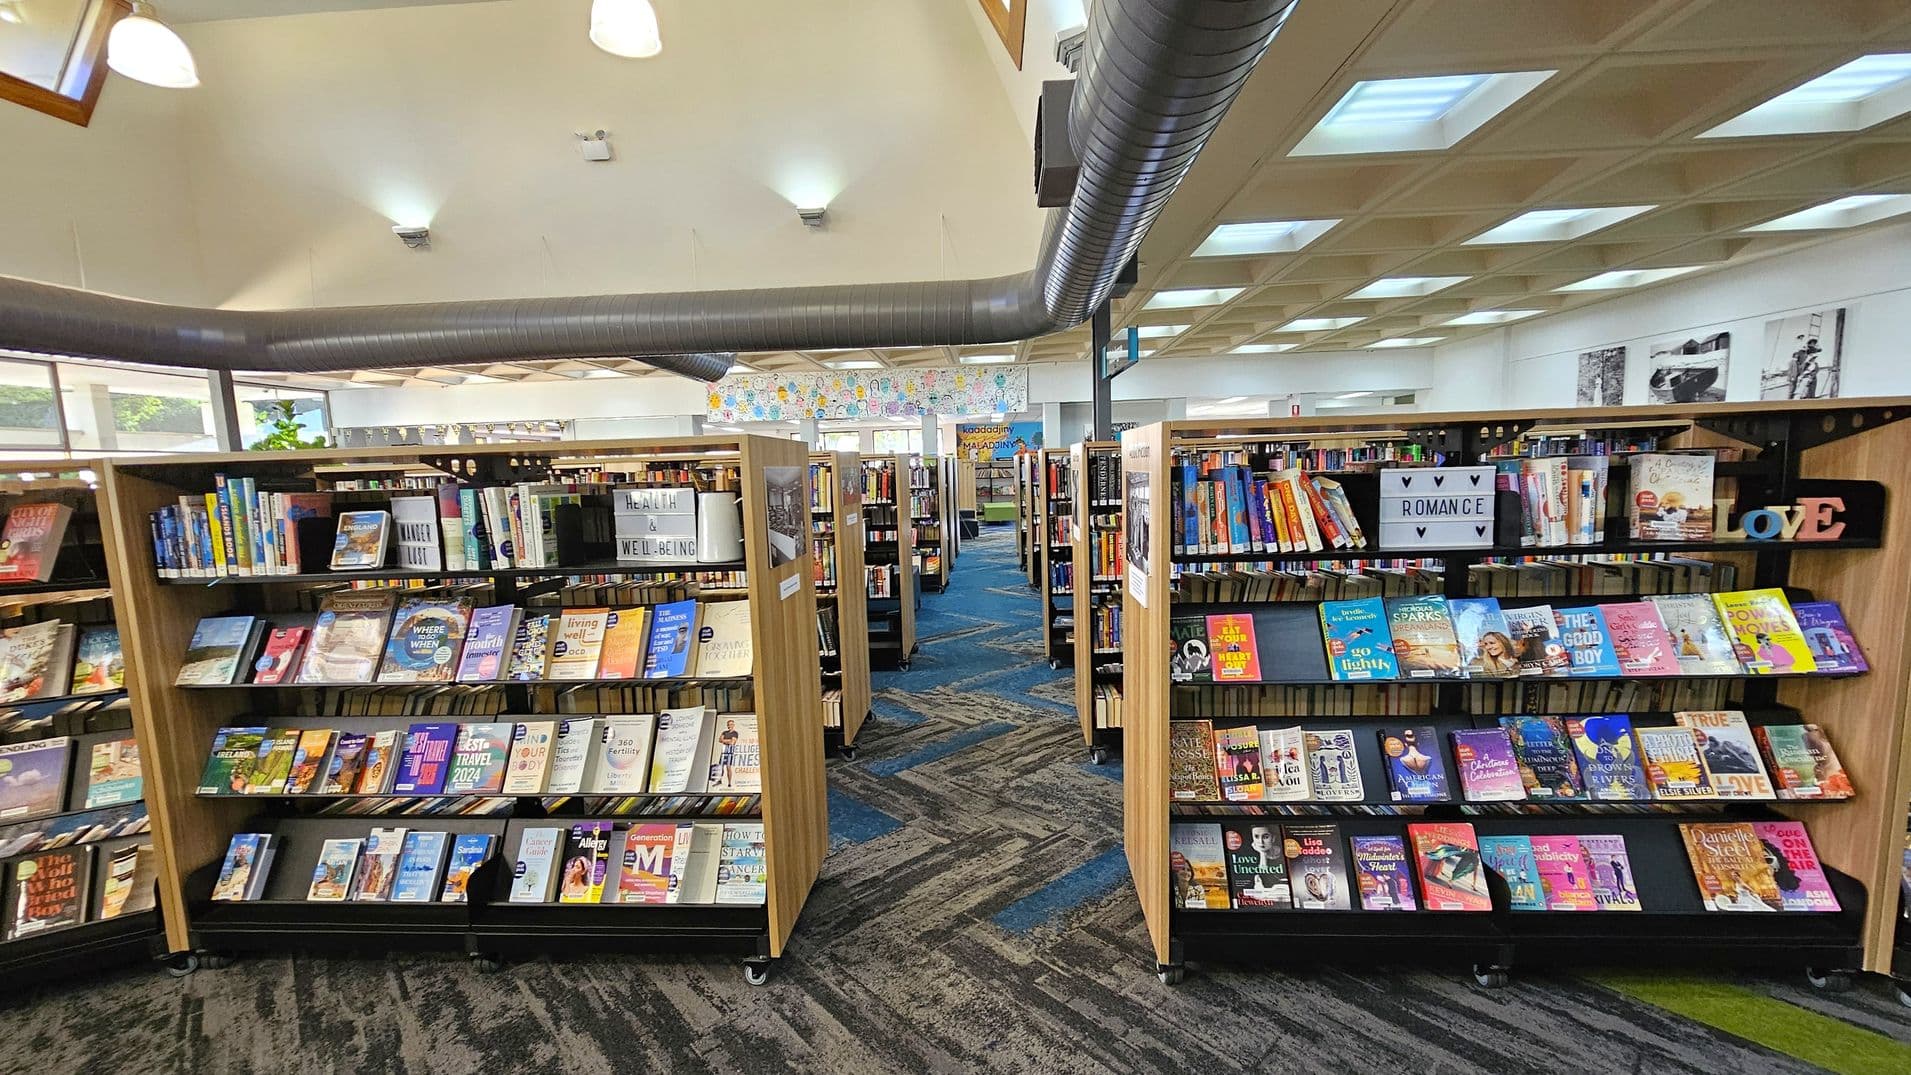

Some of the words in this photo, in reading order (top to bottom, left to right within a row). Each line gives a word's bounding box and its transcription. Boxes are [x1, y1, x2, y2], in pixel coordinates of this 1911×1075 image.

[963, 425, 1014, 434] kaadadjiny
[963, 442, 1013, 450] MALADJINY
[626, 492, 676, 509] HEALTH
[11, 508, 34, 518] CITY
[39, 507, 57, 517] OF
[1402, 499, 1484, 516] ROMANCE
[11, 517, 47, 527] NIGHT
[221, 505, 231, 536] ISLANDS
[649, 518, 656, 532] &
[8, 527, 45, 538] BIRDS
[400, 523, 431, 541] WANDER
[225, 538, 234, 558] BOOK
[408, 546, 427, 565] LUST
[658, 614, 687, 622] MADNESS
[1393, 611, 1442, 621] SPARKS
[1505, 612, 1543, 621] VIRGIN
[1563, 614, 1589, 628] THE
[568, 618, 598, 629] living
[1393, 623, 1448, 632] DREAMLAND
[1508, 618, 1550, 629] RIVER
[1733, 620, 1790, 634] MOVES
[564, 629, 586, 639] well
[1218, 633, 1247, 642] YOUR
[1564, 631, 1603, 647] GOOD
[410, 640, 440, 649] WHEN
[466, 636, 504, 652] fourth
[705, 640, 748, 651] GROWING
[466, 649, 500, 659] trimester
[705, 650, 749, 660] TOGETHER
[1219, 652, 1251, 661] HEART
[1351, 648, 1371, 656] go
[1575, 649, 1604, 664] BOY
[1226, 661, 1246, 669] OUT
[1342, 659, 1391, 671] lightly
[1690, 713, 1729, 726] TRUE
[459, 738, 485, 751] BEST
[1172, 738, 1203, 748] KATE
[1654, 733, 1693, 747] PHOTO
[423, 740, 448, 761] TRAVEL
[514, 747, 546, 758] YOUR
[608, 746, 640, 755] Fertility
[1172, 749, 1210, 759] MOSSE
[1648, 747, 1700, 763] FINISH
[456, 753, 492, 765] TRAVEL
[512, 760, 543, 771] BODY
[1276, 762, 1300, 775] idea
[1470, 760, 1510, 770] Christmas
[1588, 763, 1633, 773] DROWN
[452, 768, 480, 782] 2024
[1222, 774, 1250, 782] ELISSA
[1398, 774, 1444, 783] AMERICAN
[1470, 769, 1516, 782] Celebration
[1592, 775, 1635, 783] RIVERS
[1278, 777, 1300, 787] you
[1225, 785, 1257, 793] SLOAN
[1659, 788, 1682, 796] ELSIE
[630, 834, 673, 842] Generation
[725, 832, 751, 840] HOW
[1175, 836, 1217, 844] KELSALL
[1690, 829, 1754, 843] Danielle
[579, 838, 608, 850] Allergy
[1783, 839, 1807, 847] ON
[526, 848, 548, 856] Guide
[1704, 842, 1751, 857] Steel
[1784, 849, 1812, 859] THE
[38, 855, 71, 866] The
[632, 845, 666, 874] M
[1232, 854, 1256, 864] Love
[1358, 852, 1404, 861] Midwinter's
[731, 864, 764, 873] ANCER
[1233, 864, 1283, 874] Unedited
[1370, 862, 1397, 871] Heart
[1789, 861, 1816, 870] AIR
[28, 877, 74, 893] Who
[1430, 885, 1456, 897] KEVIN
[27, 904, 61, 918] Boy
